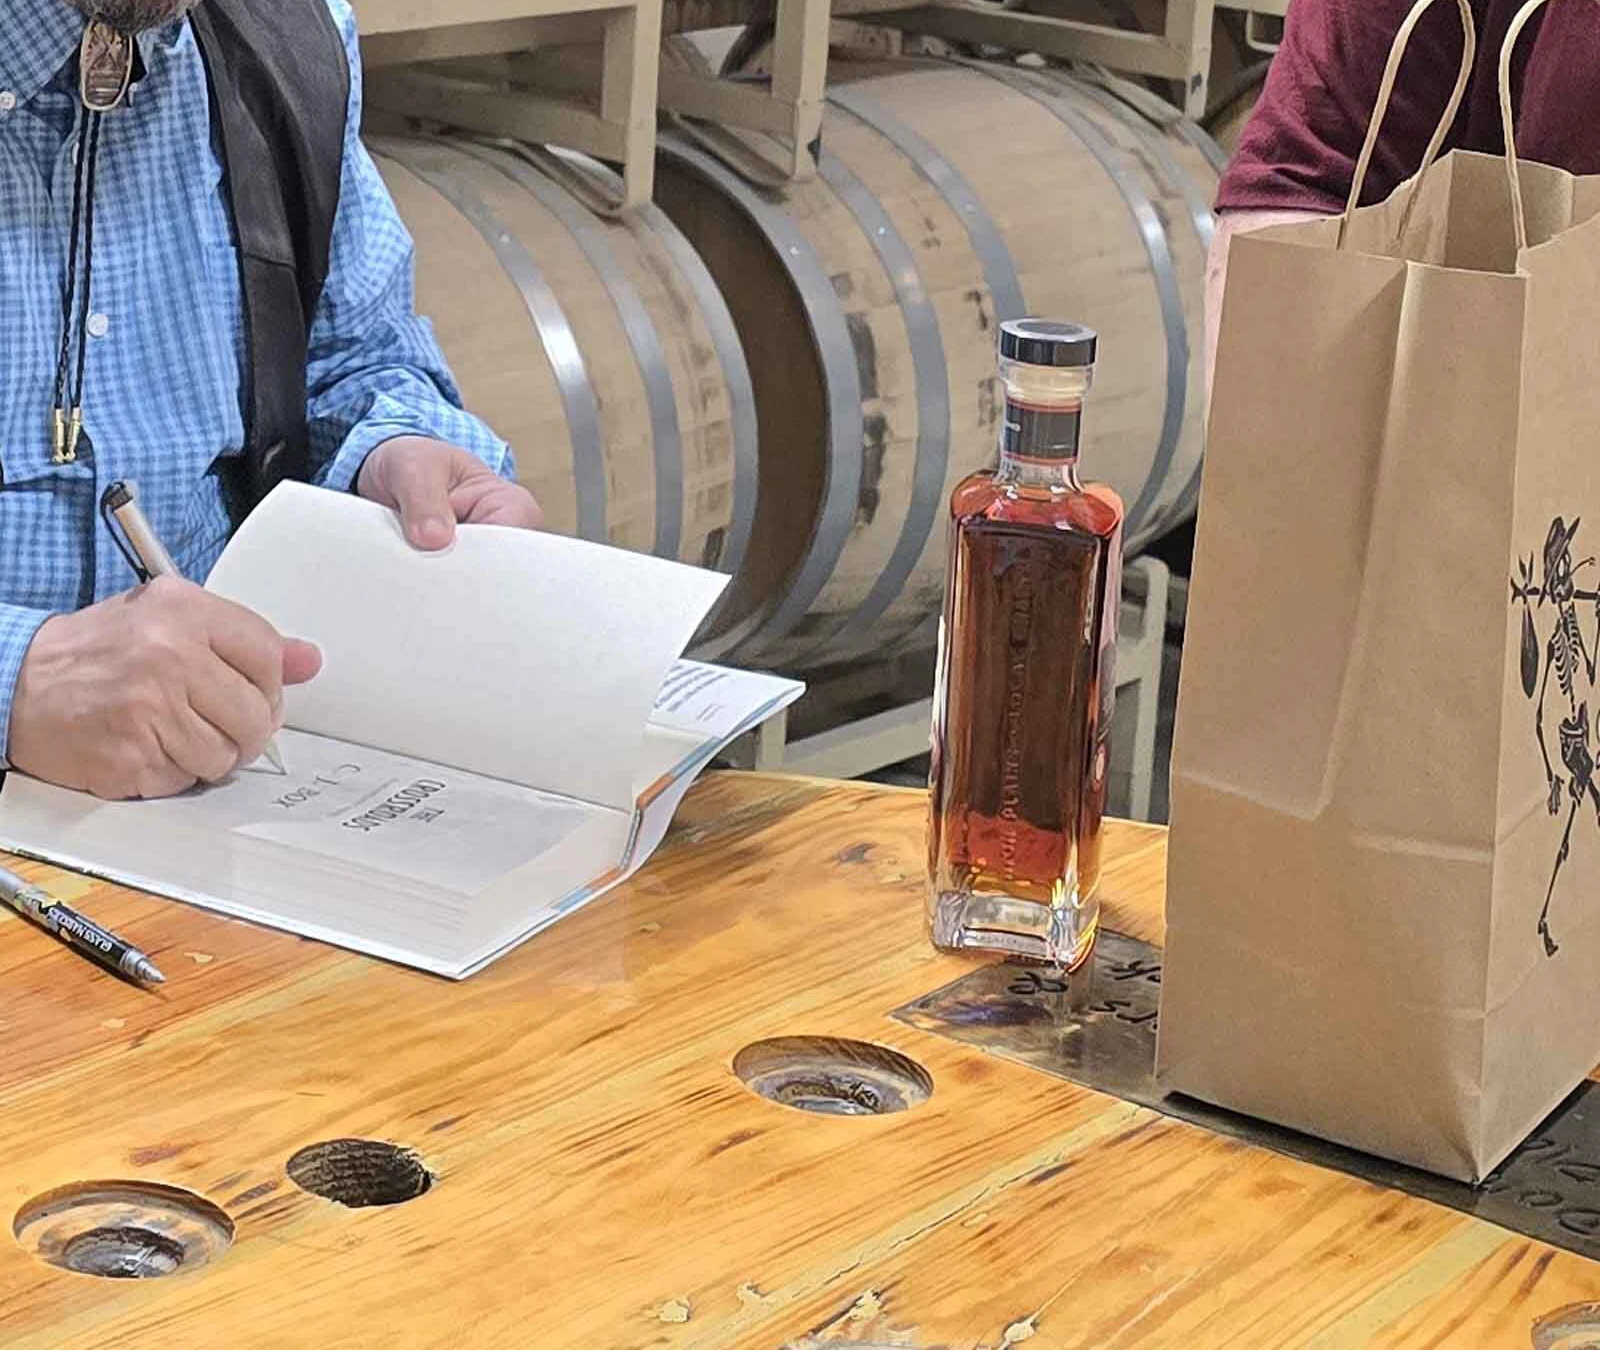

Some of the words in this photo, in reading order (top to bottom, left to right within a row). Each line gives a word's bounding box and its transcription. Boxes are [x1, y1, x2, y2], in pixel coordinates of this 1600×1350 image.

[270, 786, 321, 809] BOX
[341, 778, 446, 832] CROSSROADS
[409, 806, 446, 824] THE
[83, 928, 113, 953] GLASS
